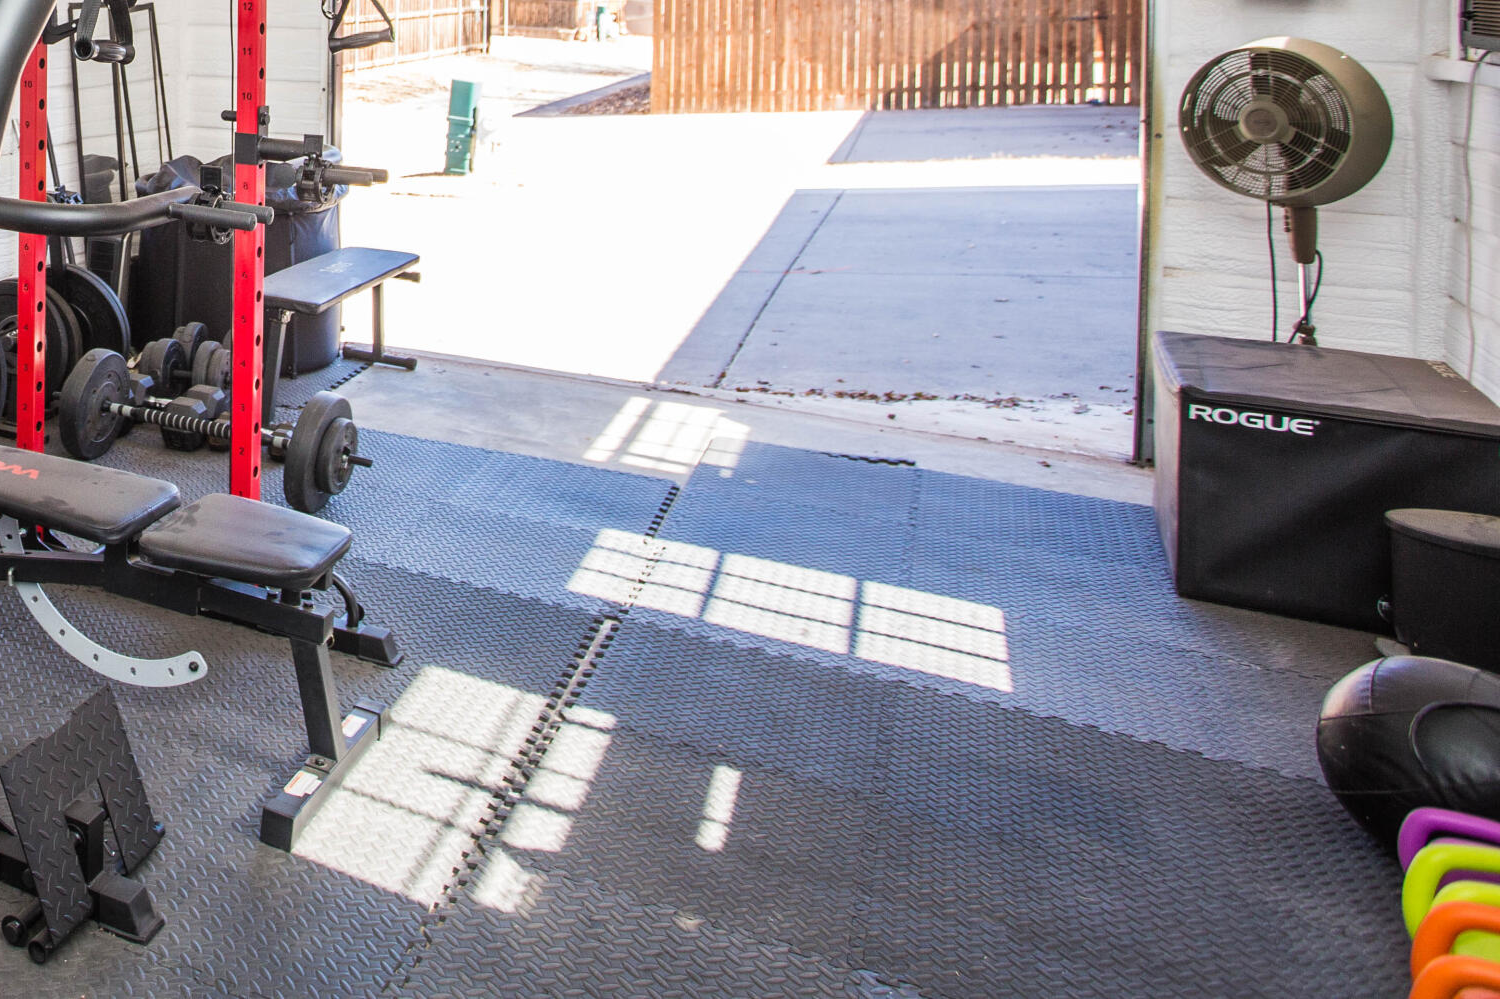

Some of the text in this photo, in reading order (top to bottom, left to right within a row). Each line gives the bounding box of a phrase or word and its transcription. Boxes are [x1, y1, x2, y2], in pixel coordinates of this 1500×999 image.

[243, 2, 253, 11] 12
[242, 47, 252, 56] 11
[24, 80, 33, 88] 10
[242, 92, 252, 101] 10
[25, 120, 30, 128] 9
[25, 162, 30, 170] 8
[24, 243, 29, 251] 6
[1188, 403, 1315, 436] ROGUE
[239, 447, 245, 456] 2
